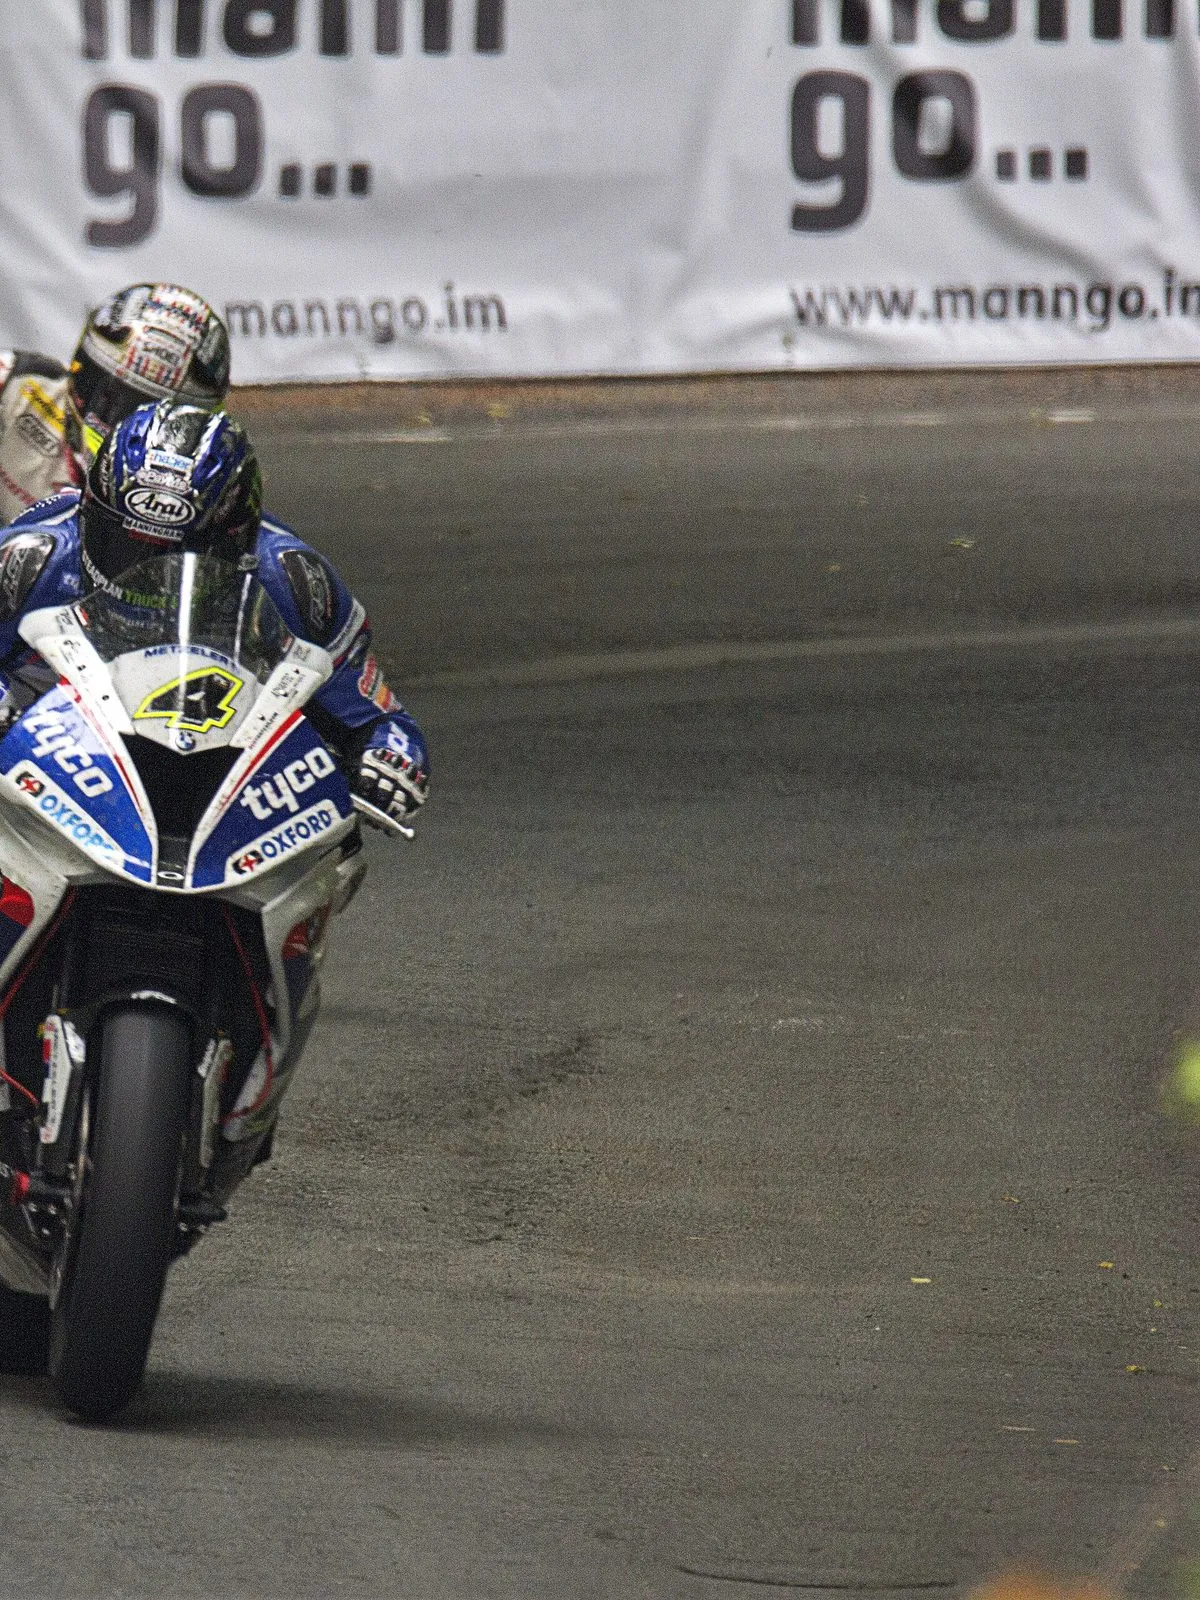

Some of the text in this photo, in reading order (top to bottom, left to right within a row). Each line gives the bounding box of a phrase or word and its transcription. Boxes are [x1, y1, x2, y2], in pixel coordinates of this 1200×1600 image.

[81, 81, 371, 247] go...
[791, 69, 1088, 232] go...
[130, 493, 186, 518] Arai
[144, 645, 228, 666] METELER
[133, 666, 244, 733] 4
[22, 705, 114, 798] tyco
[240, 747, 337, 821] tyco
[261, 809, 332, 858] OXFORD
